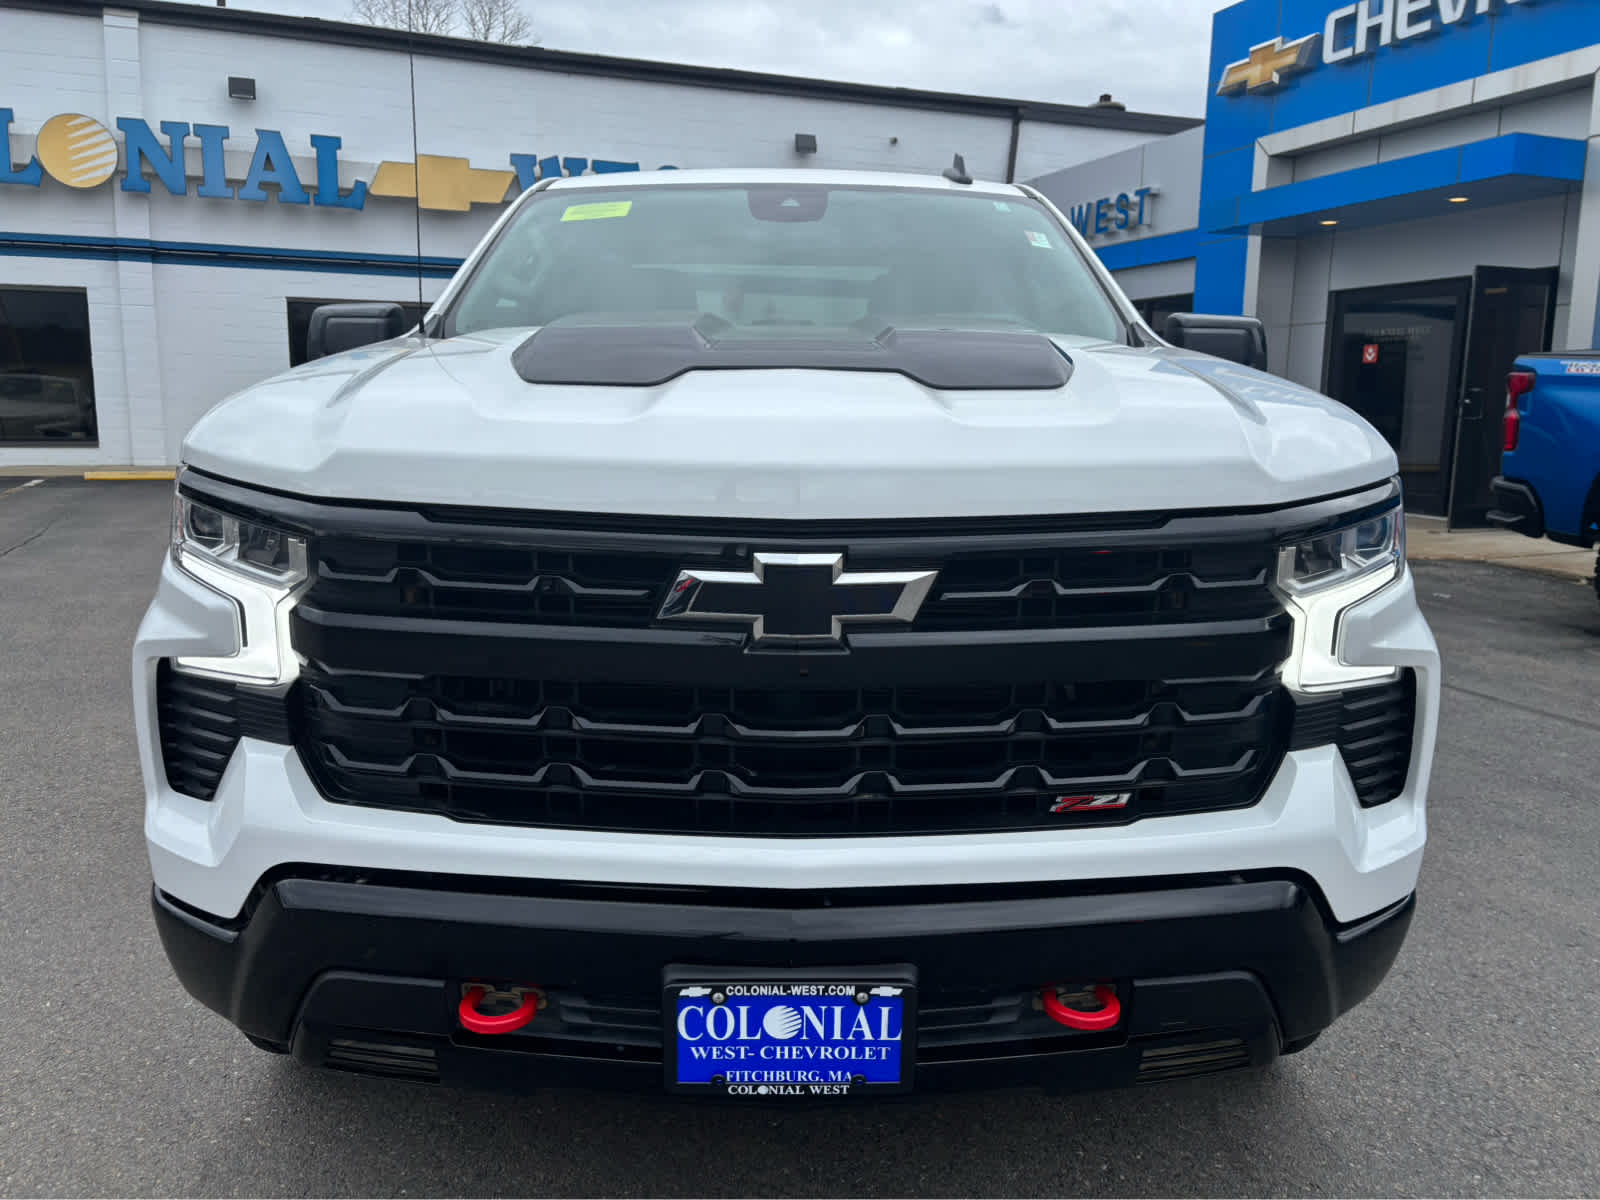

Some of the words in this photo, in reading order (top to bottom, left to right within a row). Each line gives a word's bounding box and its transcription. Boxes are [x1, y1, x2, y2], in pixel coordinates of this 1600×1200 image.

[1070, 187, 1151, 238] WEST
[1049, 793, 1131, 813] Z71
[726, 985, 855, 997] COLONIAL-WEST.COM
[677, 1005, 902, 1041] COLONIAL
[726, 1070, 824, 1083] FITCHBURG,
[828, 1070, 852, 1082] MA
[727, 1085, 804, 1095] COLONIAL
[809, 1085, 850, 1095] WEST
